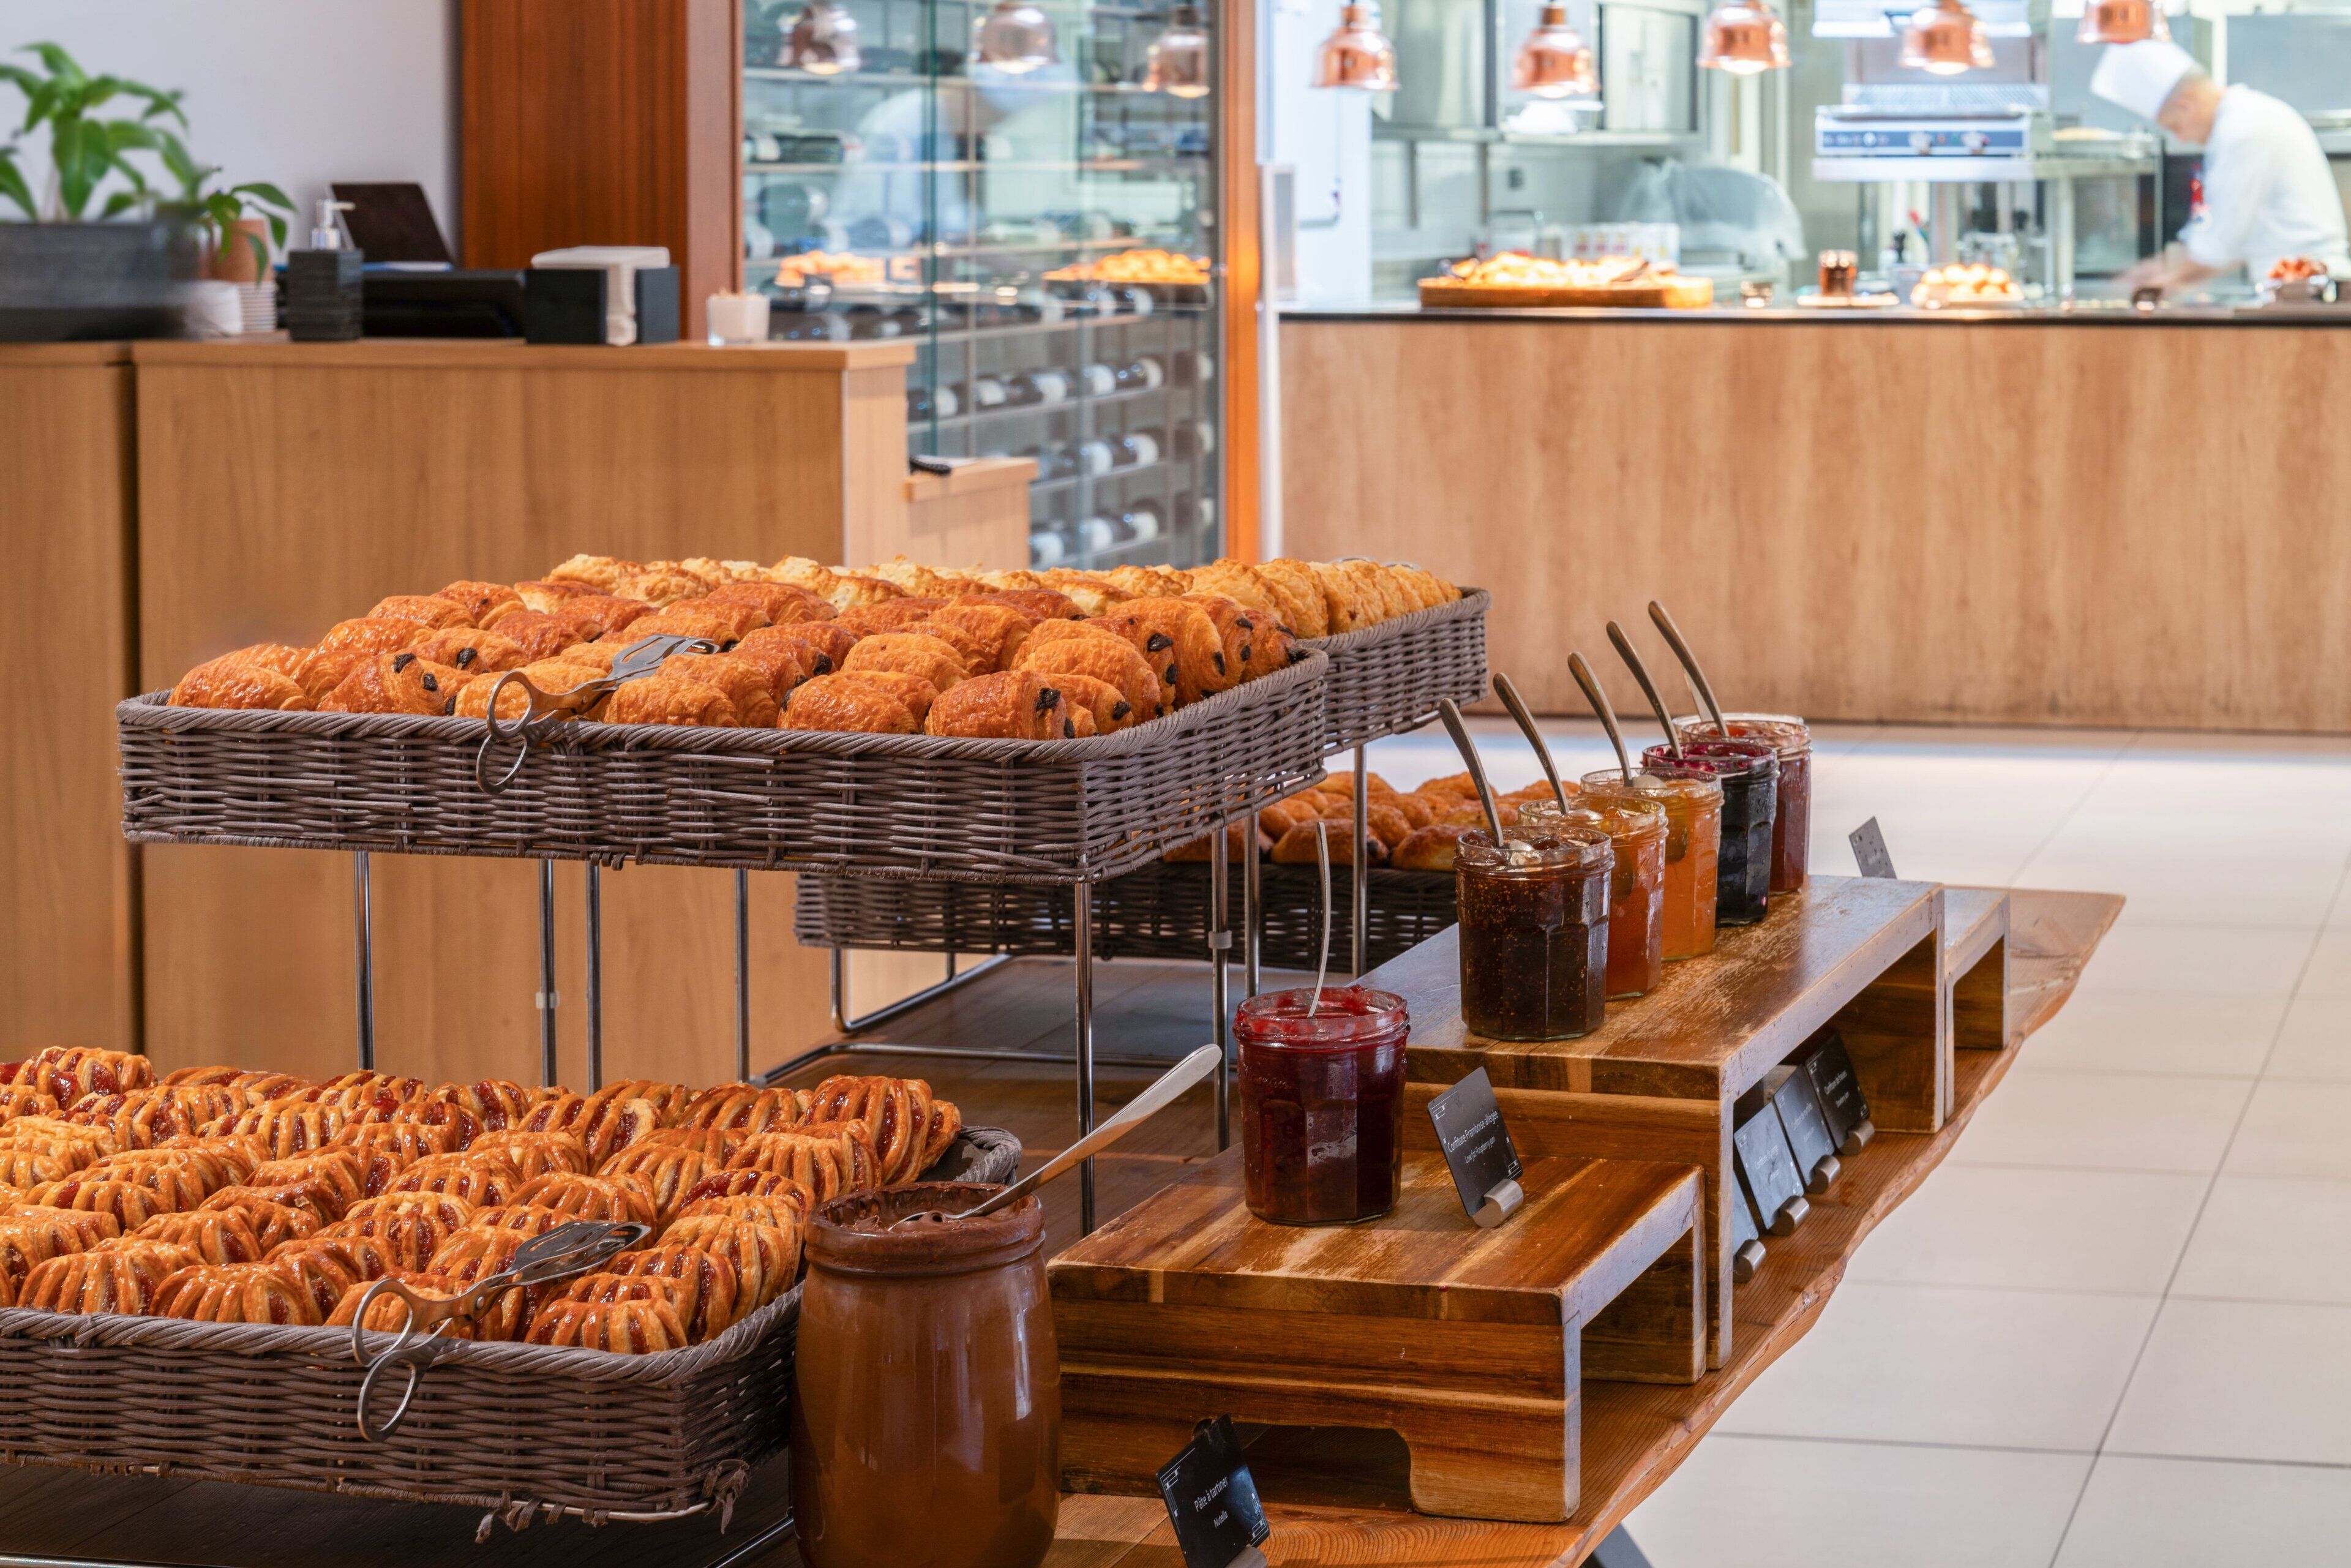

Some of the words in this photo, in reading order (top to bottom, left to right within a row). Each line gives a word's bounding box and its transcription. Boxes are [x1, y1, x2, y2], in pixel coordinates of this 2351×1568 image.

[1447, 1134, 1466, 1153] Confiture
[1464, 1120, 1486, 1139] Framboise
[1485, 1111, 1499, 1126] allégée
[1194, 1495, 1207, 1512] Pâte
[1205, 1490, 1212, 1502] à
[1210, 1477, 1229, 1497] tartiner
[1213, 1510, 1229, 1528] Nutella
